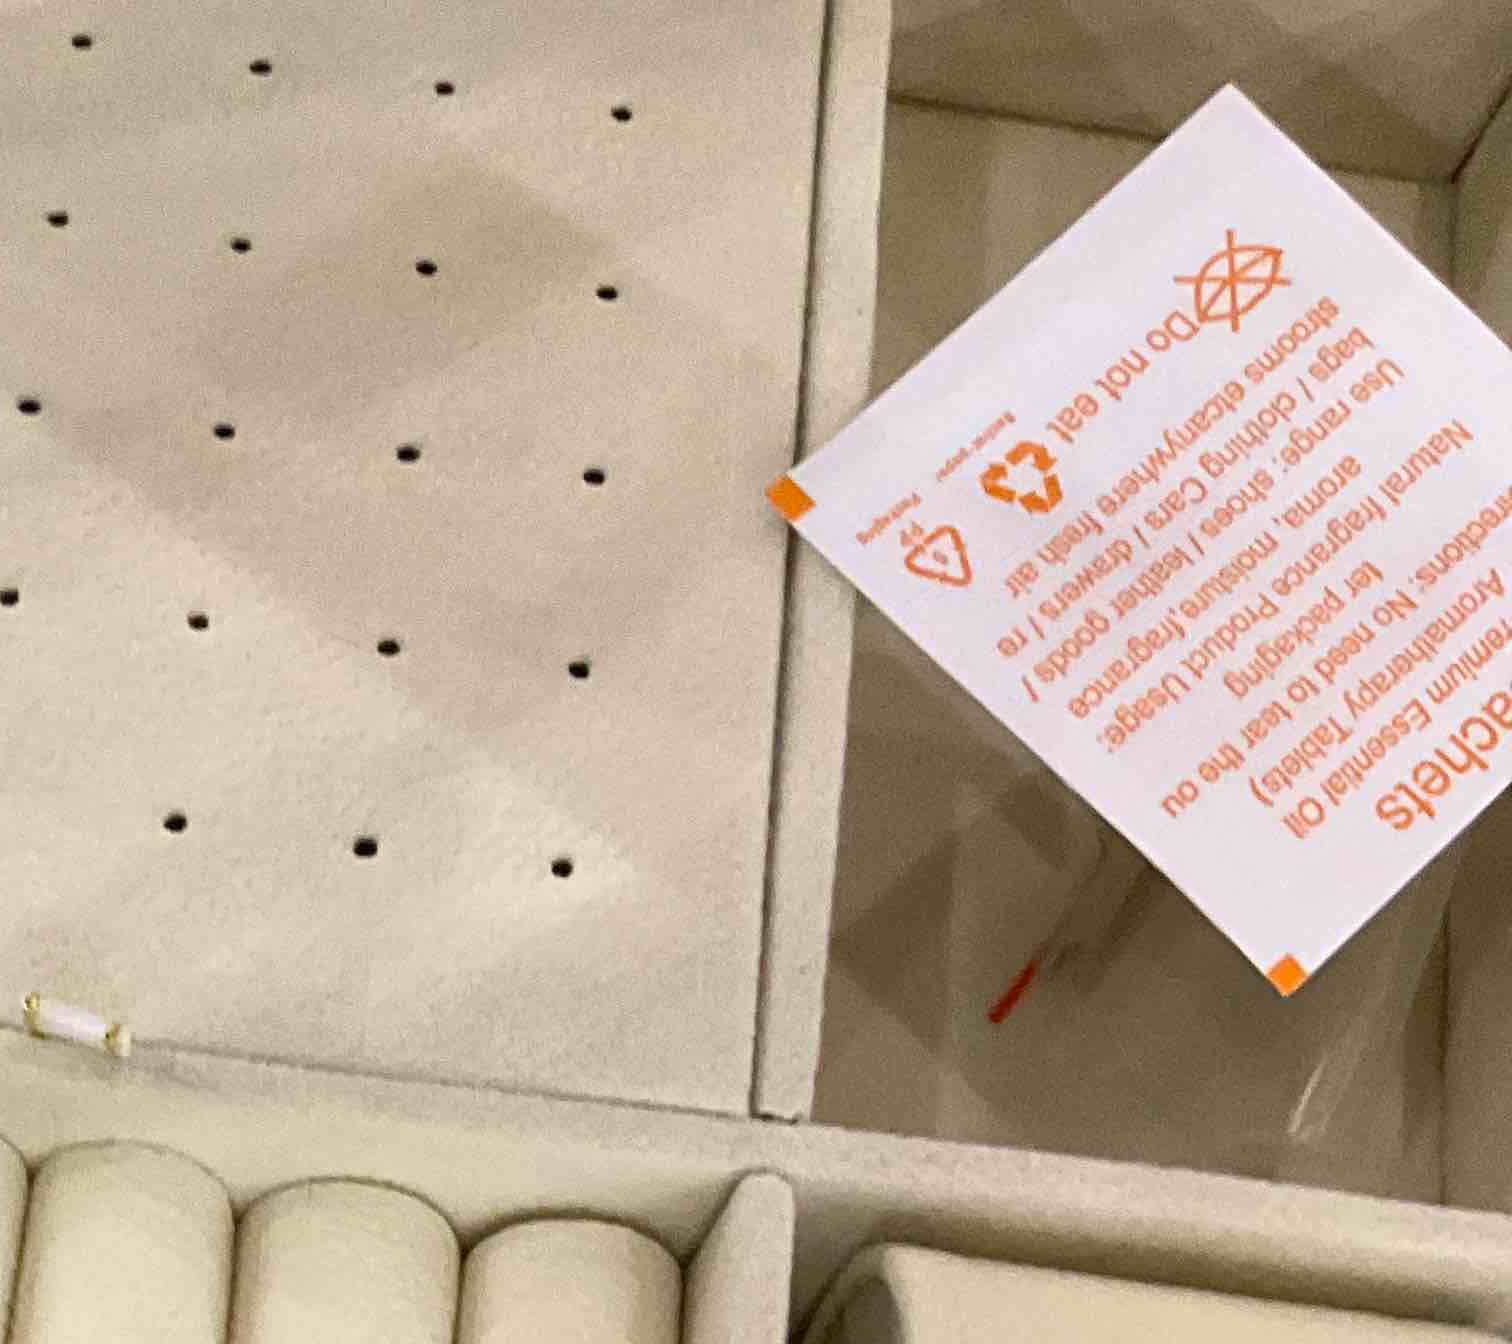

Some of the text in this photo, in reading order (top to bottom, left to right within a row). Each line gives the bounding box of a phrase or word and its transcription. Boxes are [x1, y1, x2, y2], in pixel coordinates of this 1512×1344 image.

[1045, 309, 1200, 444] Do not eat
[1307, 325, 1375, 383] bags
[1348, 357, 1405, 403] Use
[1197, 390, 1297, 480] clothing
[1272, 398, 1352, 473] range:
[1142, 476, 1209, 531] Cars
[1198, 468, 1274, 539] shoes
[1271, 454, 1362, 529] aroma,
[1035, 510, 1104, 565] fresh
[1003, 559, 1039, 599] air
[1037, 538, 1134, 620] drawers
[1095, 419, 1474, 753] Natural fragrance Product Usage:
[1109, 545, 1194, 620] leather
[995, 626, 1029, 658] re
[1032, 609, 1111, 684] goods
[1158, 487, 1512, 819] irections: No need to tear the ou
[1222, 559, 1385, 700] ter packaging
[1248, 567, 1504, 808] Aromatherapy Tablets)
[1280, 619, 1512, 840] remium Essential Oil
[1374, 690, 1512, 832] achets
